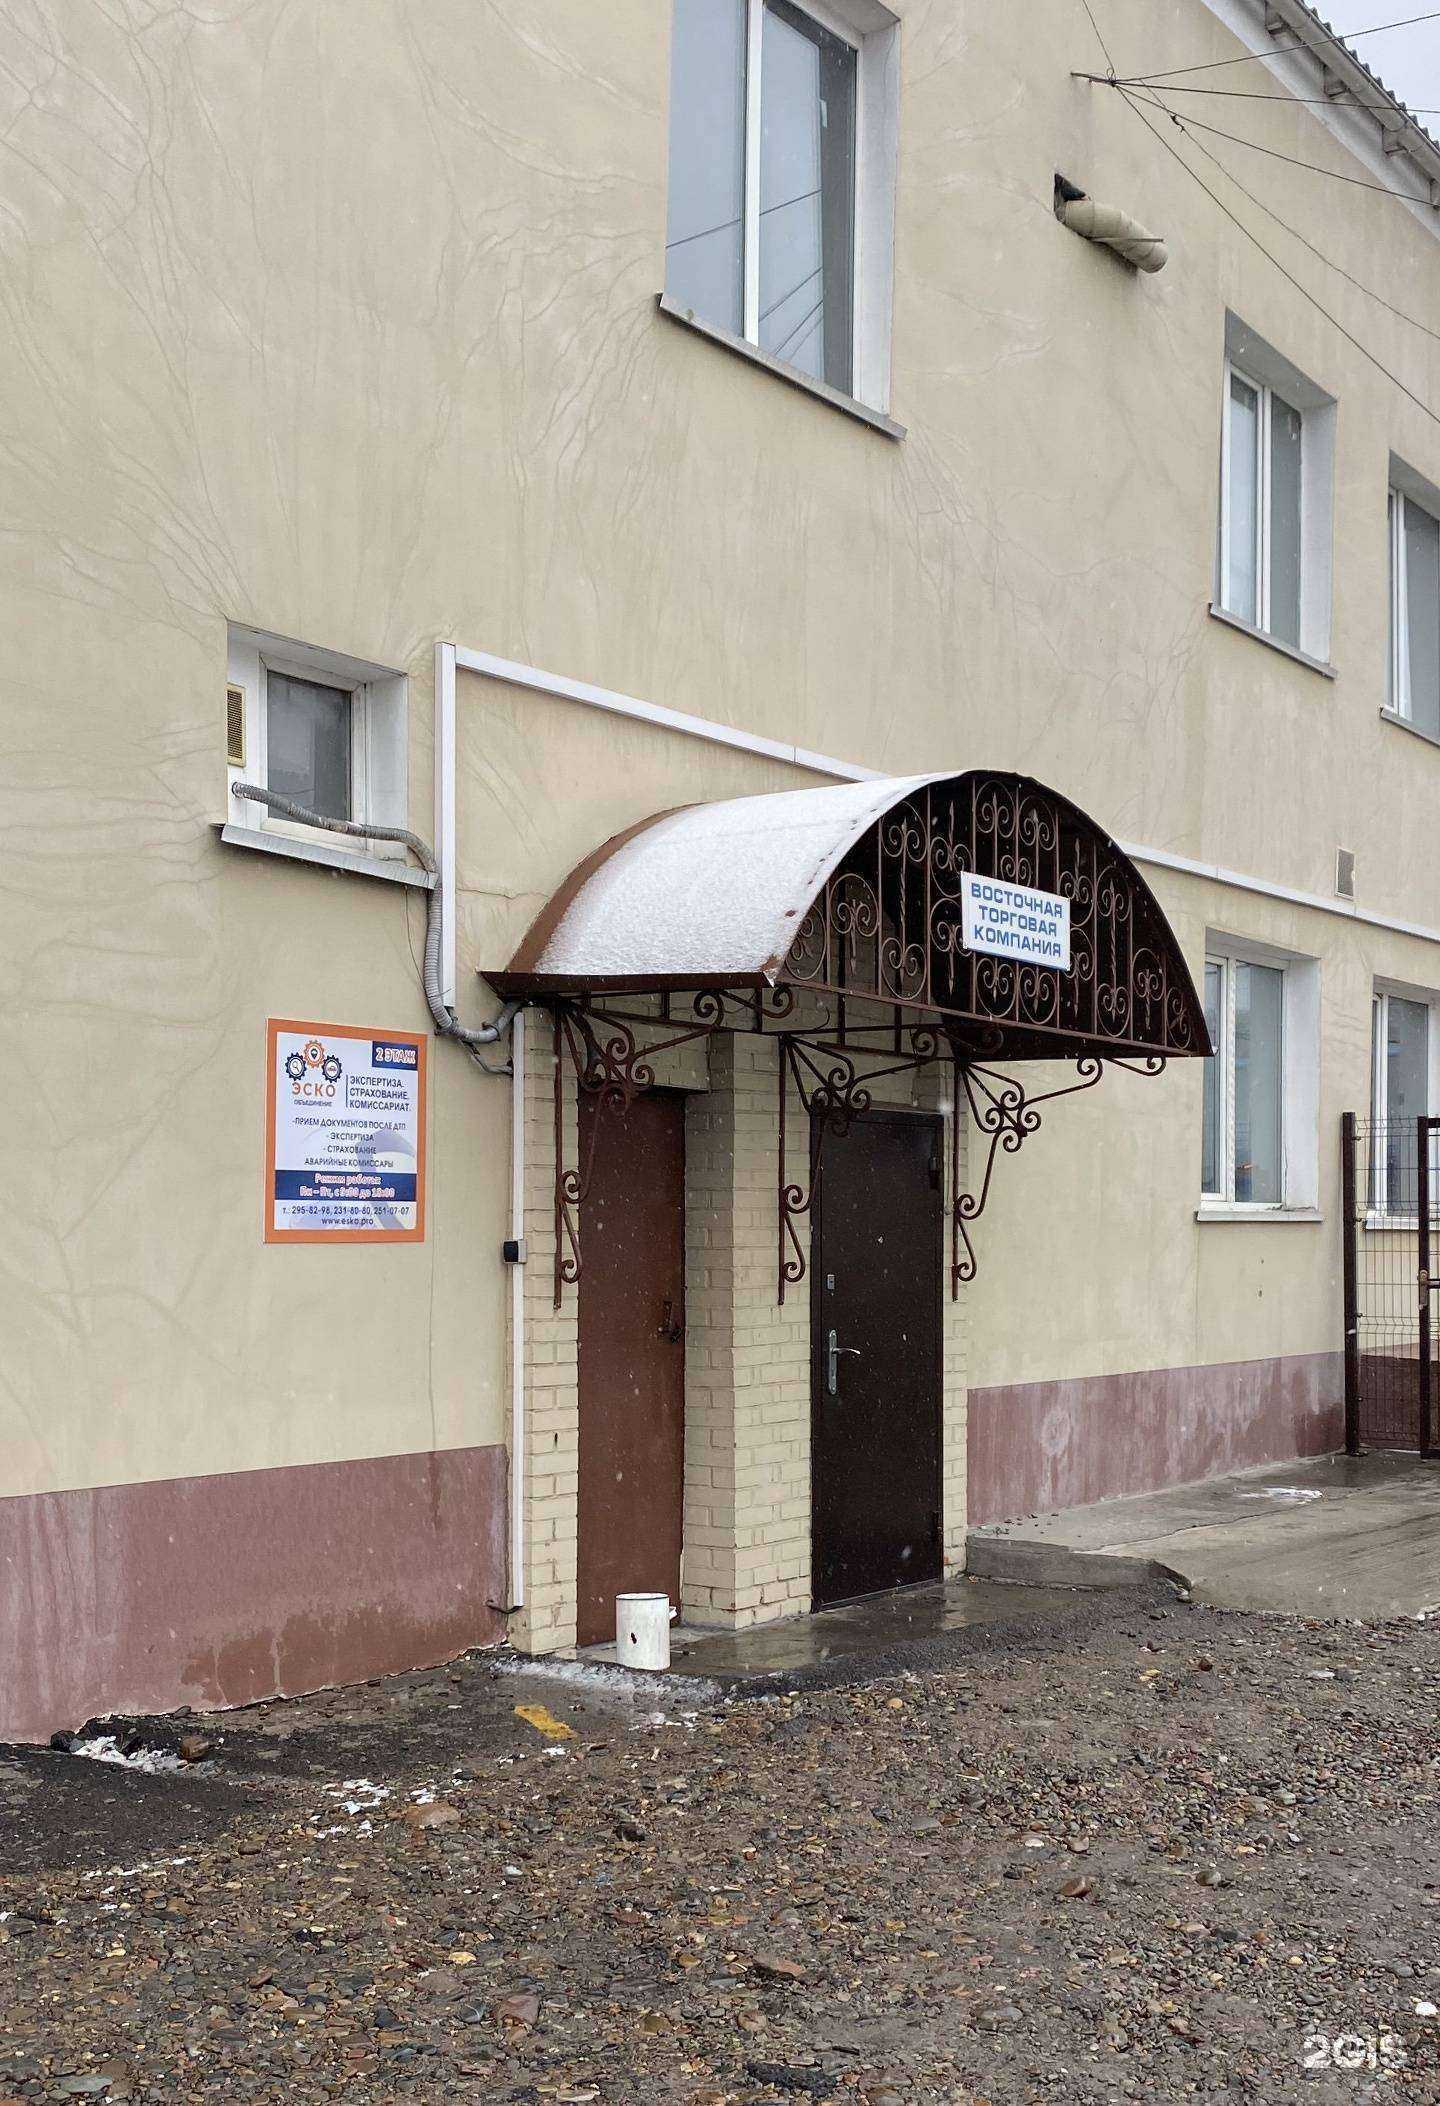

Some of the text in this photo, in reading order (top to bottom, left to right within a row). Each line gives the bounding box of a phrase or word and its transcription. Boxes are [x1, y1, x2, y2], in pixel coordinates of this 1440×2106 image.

[971, 882, 1063, 918] ВОСТОЧНАЯ
[978, 904, 1057, 937] ТОРГОВАЯ
[974, 924, 1062, 957] КОМПАНИЯ
[375, 1047, 416, 1064] 2 ЭТАЖ
[292, 1081, 336, 1097] ЭСКО
[350, 1099, 411, 1111] КОМИССАРИАТ.
[320, 1118, 368, 1128] ДОКУМЕНТОВ
[369, 1120, 393, 1129] ПОСЛЕ
[330, 1132, 374, 1142] ЭКСПЕРТИЗА
[327, 1145, 377, 1155] СТРАХОВАНИЕ
[304, 1157, 394, 1168] АВАРИЙНЫЕ КОМИССАРЫ
[321, 1217, 374, 1226] www.esko.pro
